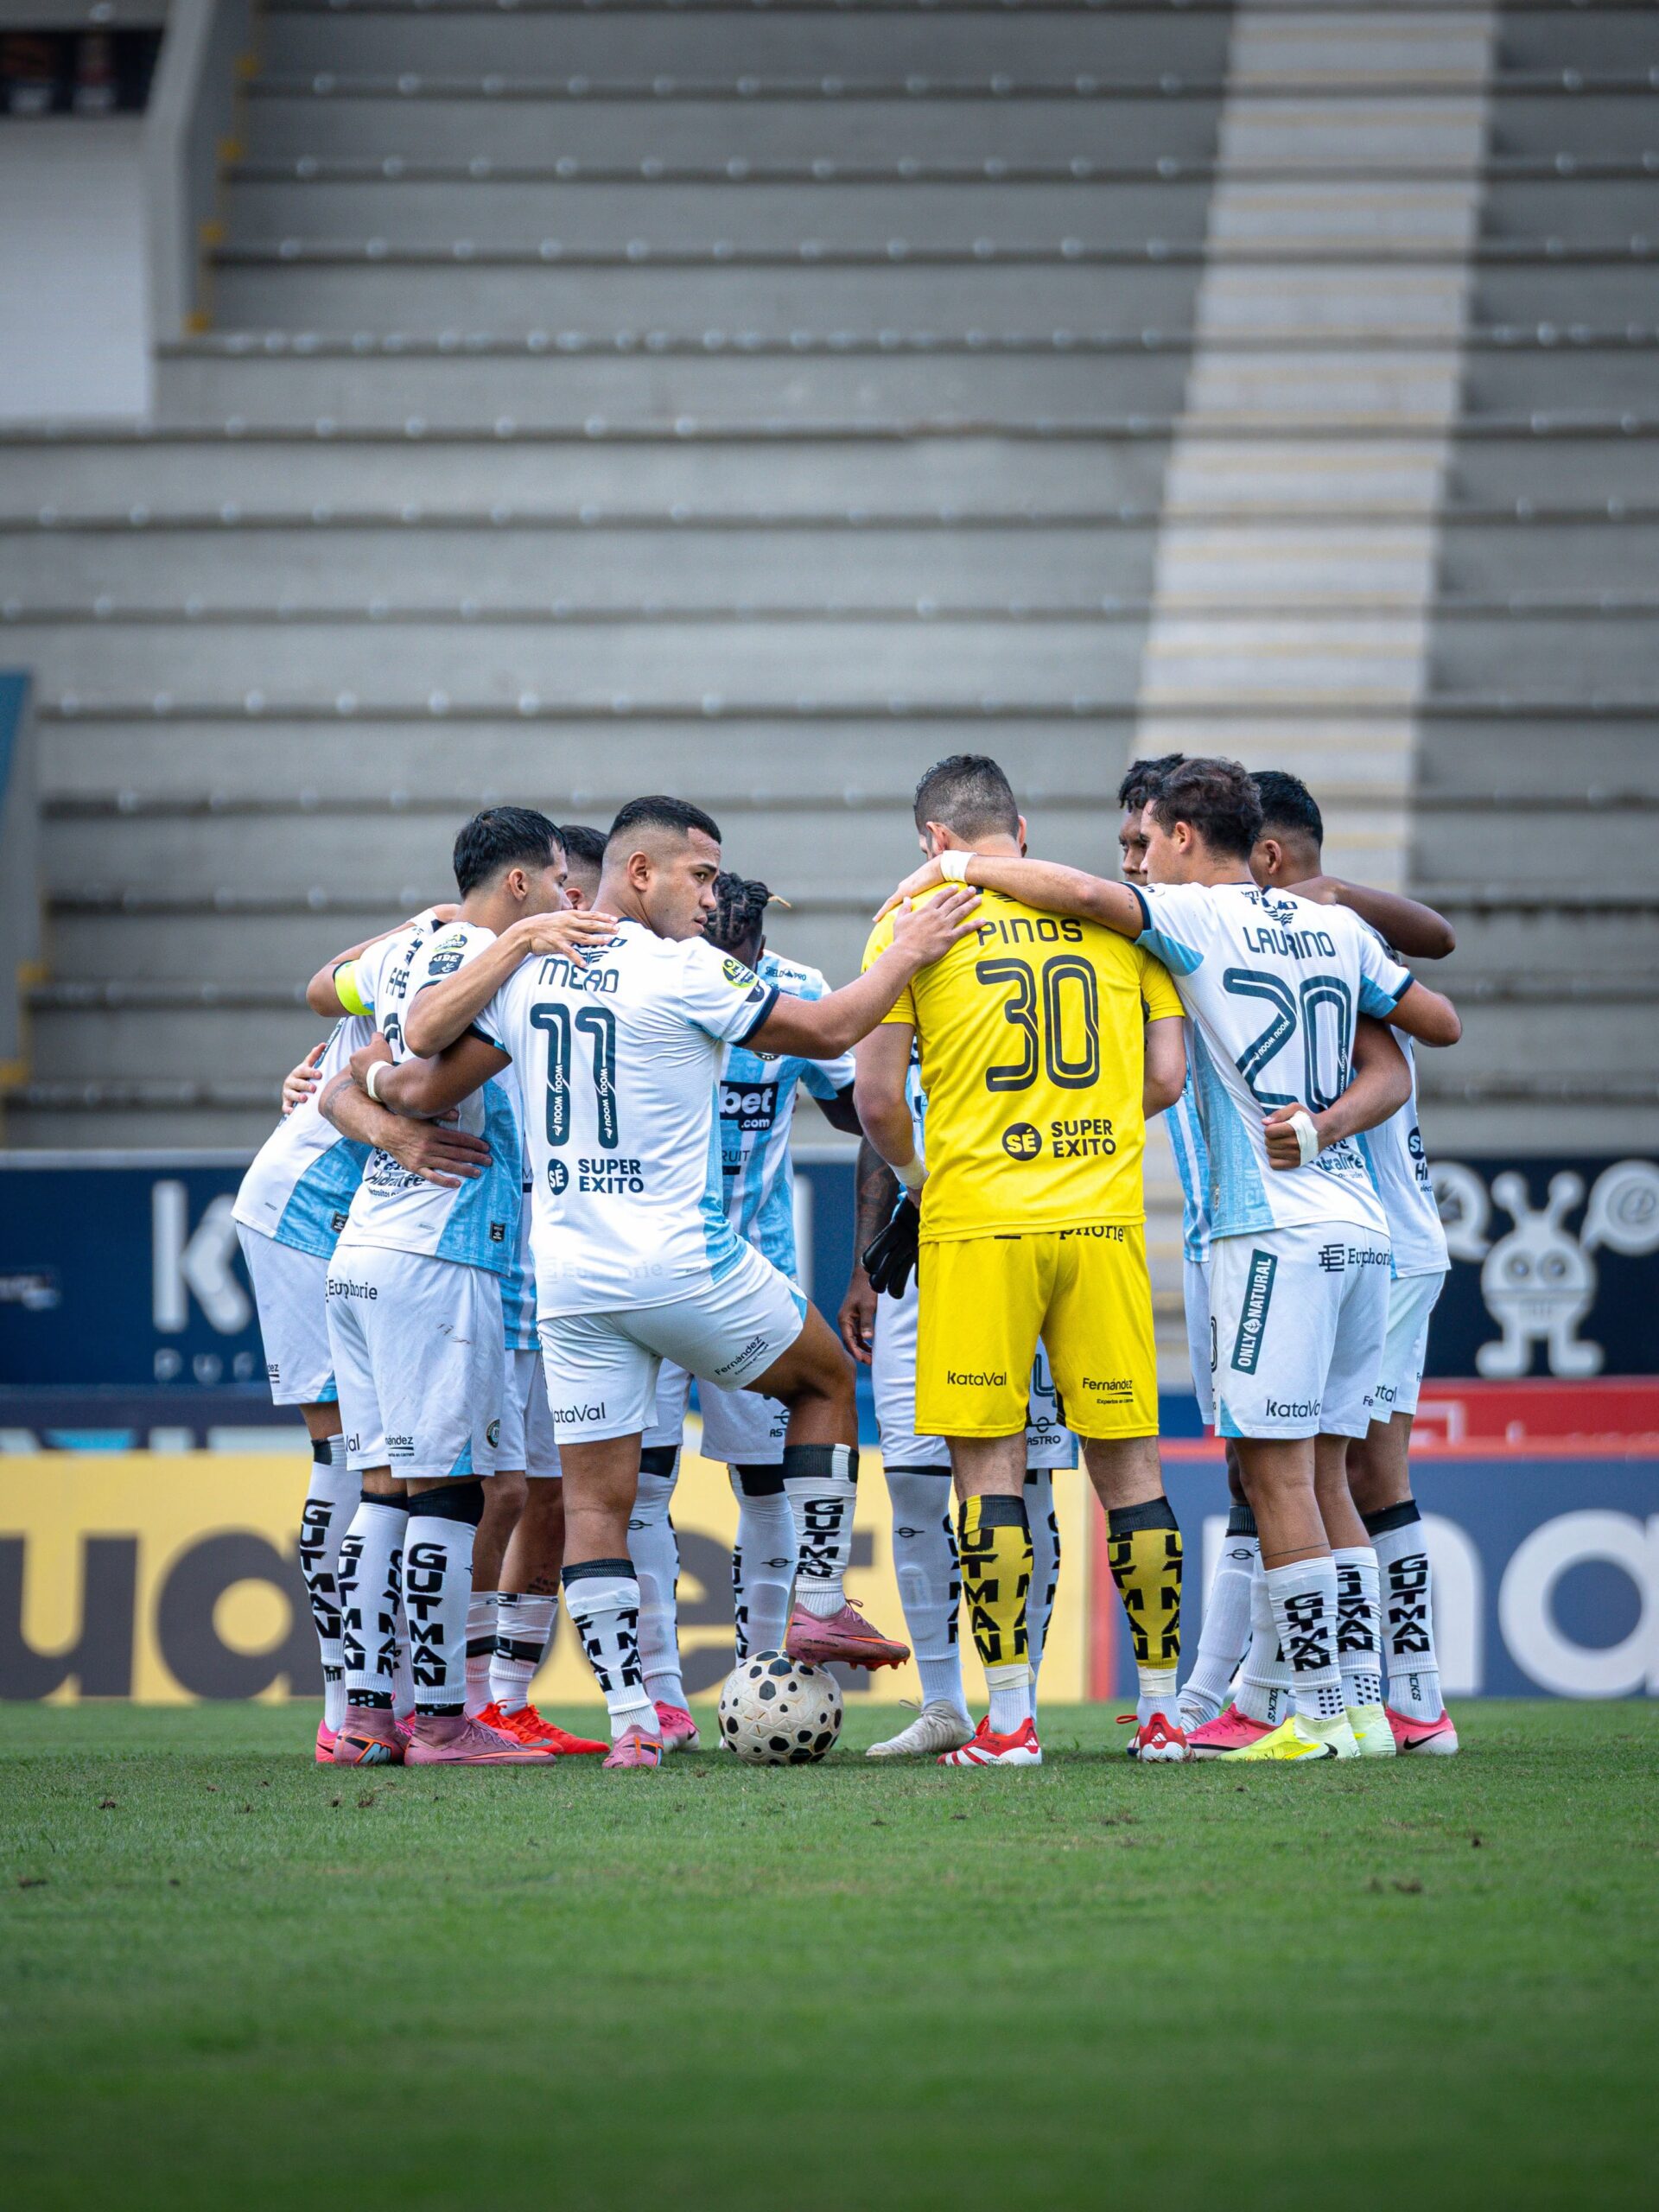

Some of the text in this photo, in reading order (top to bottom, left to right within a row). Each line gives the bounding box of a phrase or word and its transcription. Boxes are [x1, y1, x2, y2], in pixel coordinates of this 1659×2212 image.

[976, 918, 1083, 945] PINOS
[976, 954, 1100, 1092] 30
[1223, 968, 1351, 1116] 20
[741, 1118, 770, 1128] .com
[1051, 1119, 1113, 1138] SUPER
[1006, 1128, 1037, 1154] SÉ
[1052, 1138, 1116, 1158] EXITO
[549, 1163, 564, 1188] SÉ
[578, 1159, 642, 1174] SUPER
[579, 1177, 645, 1193] EXITO
[328, 1280, 378, 1300] Euphorie
[1248, 1258, 1272, 1319] NATURAL
[1238, 1333, 1256, 1367] ONLY
[947, 1370, 1007, 1386] KataVal
[552, 1402, 606, 1423] ataVal
[406, 1542, 448, 1687] GUTMAN
[1389, 1553, 1431, 1655] GUTMAN
